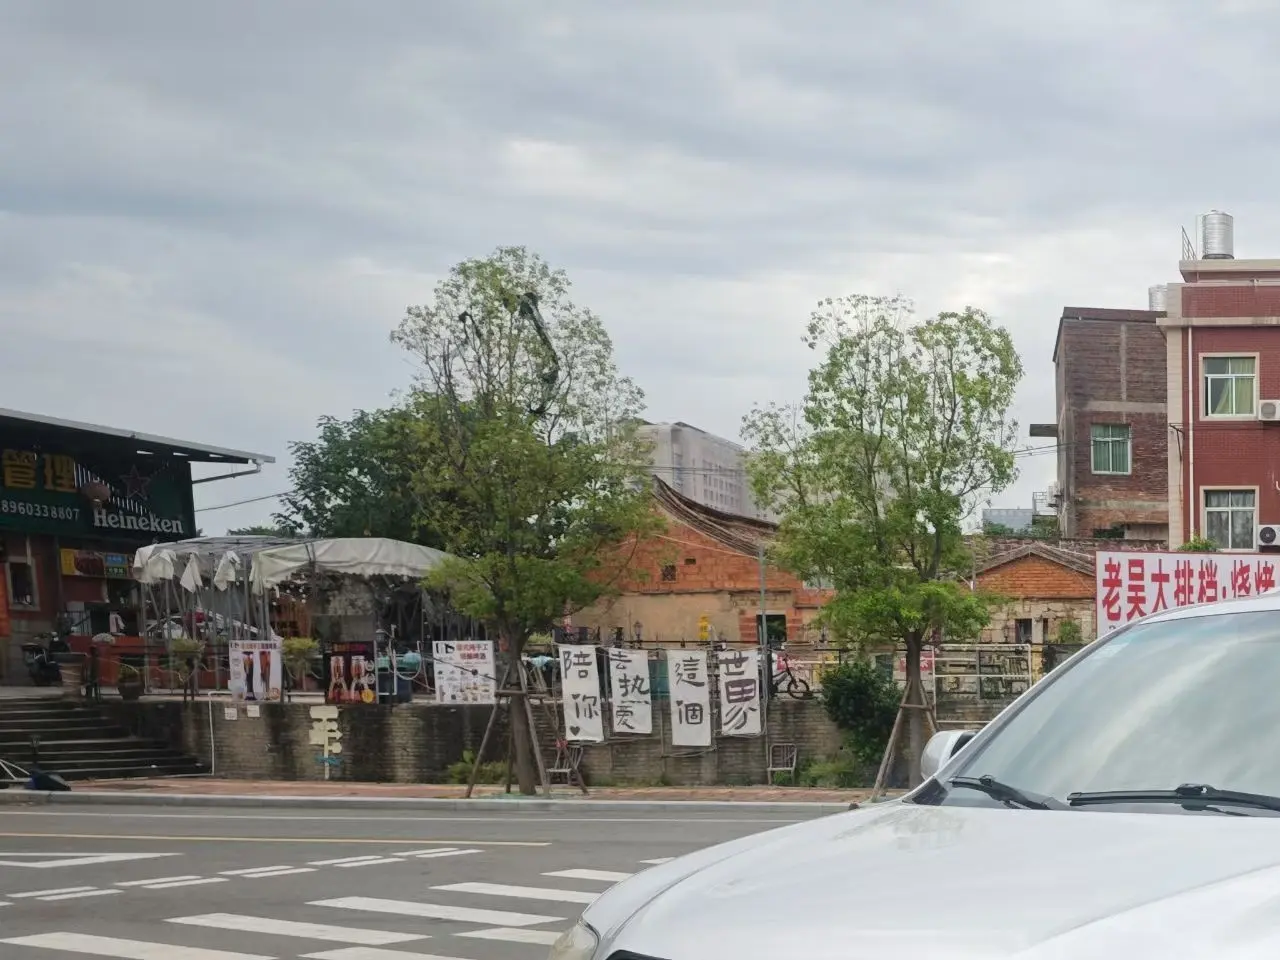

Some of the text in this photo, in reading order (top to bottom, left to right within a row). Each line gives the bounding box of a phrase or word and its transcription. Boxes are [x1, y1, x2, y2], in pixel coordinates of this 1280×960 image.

[3, 450, 77, 492] 管理
[93, 508, 184, 535] Heineken
[562, 650, 600, 719] 陪你
[719, 651, 758, 730] 世界
